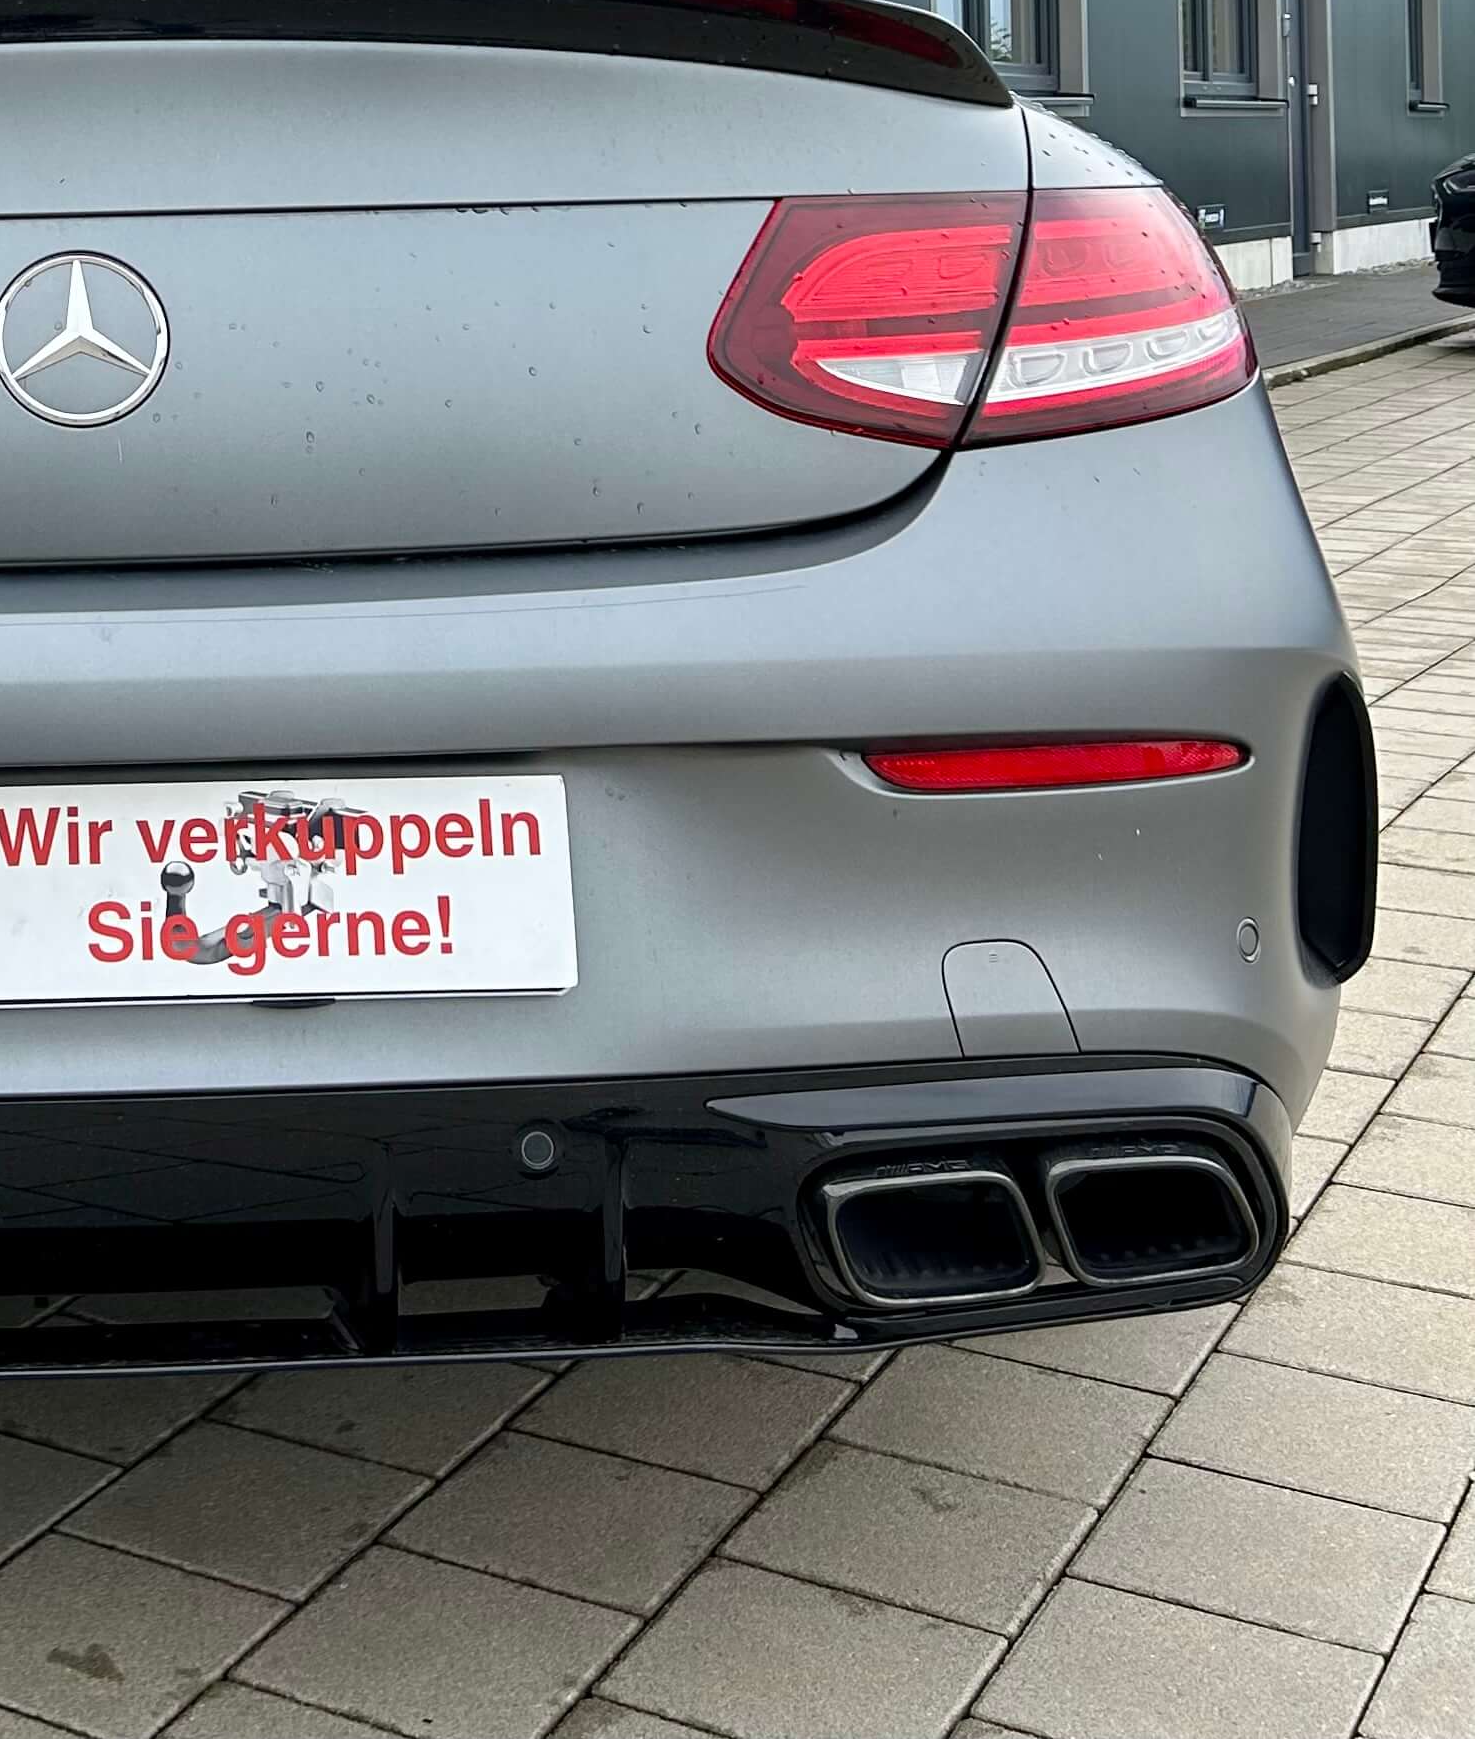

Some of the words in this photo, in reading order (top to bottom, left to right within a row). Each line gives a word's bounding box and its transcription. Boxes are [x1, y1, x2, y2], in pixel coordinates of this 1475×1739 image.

[136, 798, 542, 876] verkuppeln
[88, 899, 199, 963] Sie
[225, 894, 454, 977] gerne!
